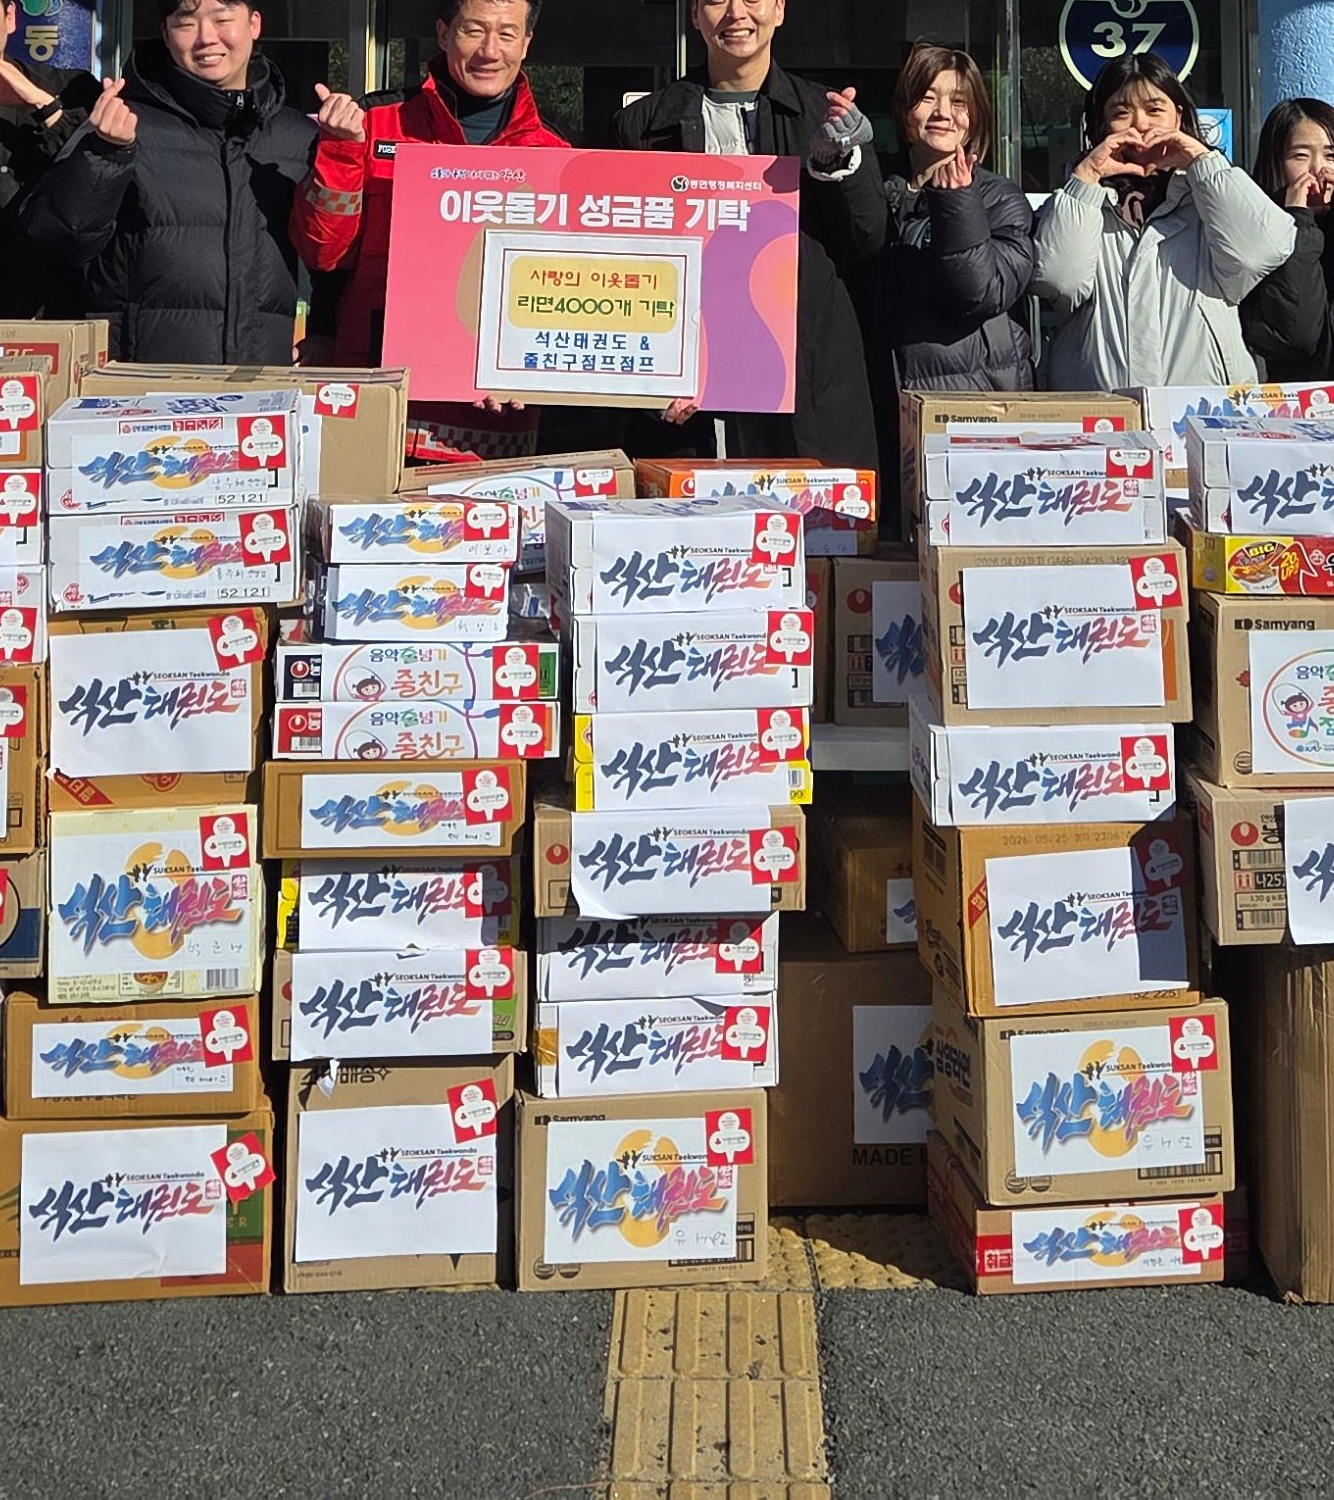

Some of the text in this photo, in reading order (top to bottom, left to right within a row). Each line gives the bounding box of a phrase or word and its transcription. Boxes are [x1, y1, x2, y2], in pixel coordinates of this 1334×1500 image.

[1090, 22, 1167, 58] 37
[440, 189, 751, 232] 이웃돕기 성금품 기탁
[530, 269, 657, 290] 사랑의 이웃돕기
[639, 300, 675, 318] 기탁
[535, 332, 650, 351] 석산태권도 &
[524, 352, 655, 373] 줄친구점프점프
[218, 495, 234, 504] 52
[1249, 543, 1275, 557] BIG
[220, 589, 236, 598] 52
[1254, 619, 1315, 631] Samyang
[851, 1147, 913, 1167] MADE
